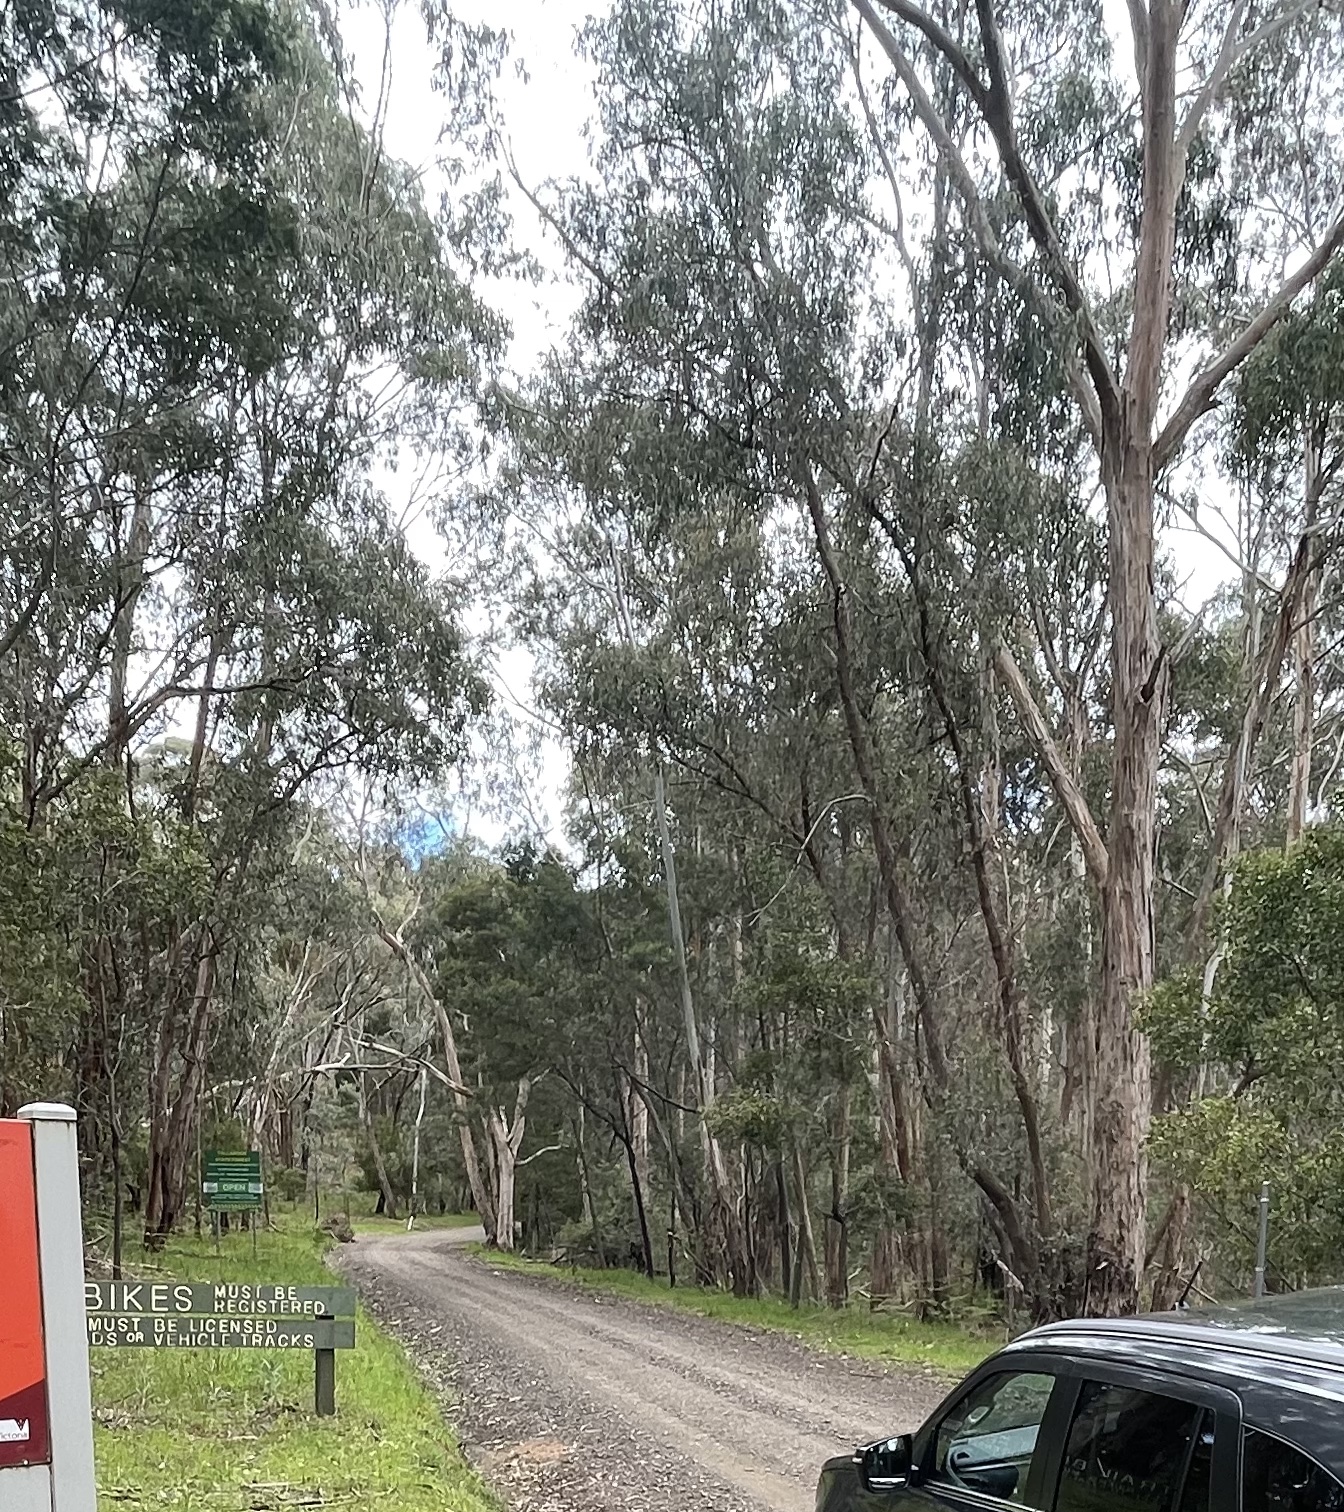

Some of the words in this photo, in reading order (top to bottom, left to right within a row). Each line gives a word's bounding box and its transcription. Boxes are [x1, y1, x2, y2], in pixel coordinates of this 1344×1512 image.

[222, 1183, 246, 1192] OPEN
[84, 1282, 193, 1312] BIKES
[214, 1284, 262, 1300] MUST
[274, 1286, 298, 1301] BE
[214, 1299, 325, 1315] REGISTERED
[88, 1317, 141, 1332] MUST
[154, 1318, 178, 1333] BE
[189, 1318, 277, 1334] LICENSED
[126, 1331, 144, 1343] OR
[153, 1333, 231, 1347] VEHICLE
[240, 1333, 314, 1348] TRACKS
